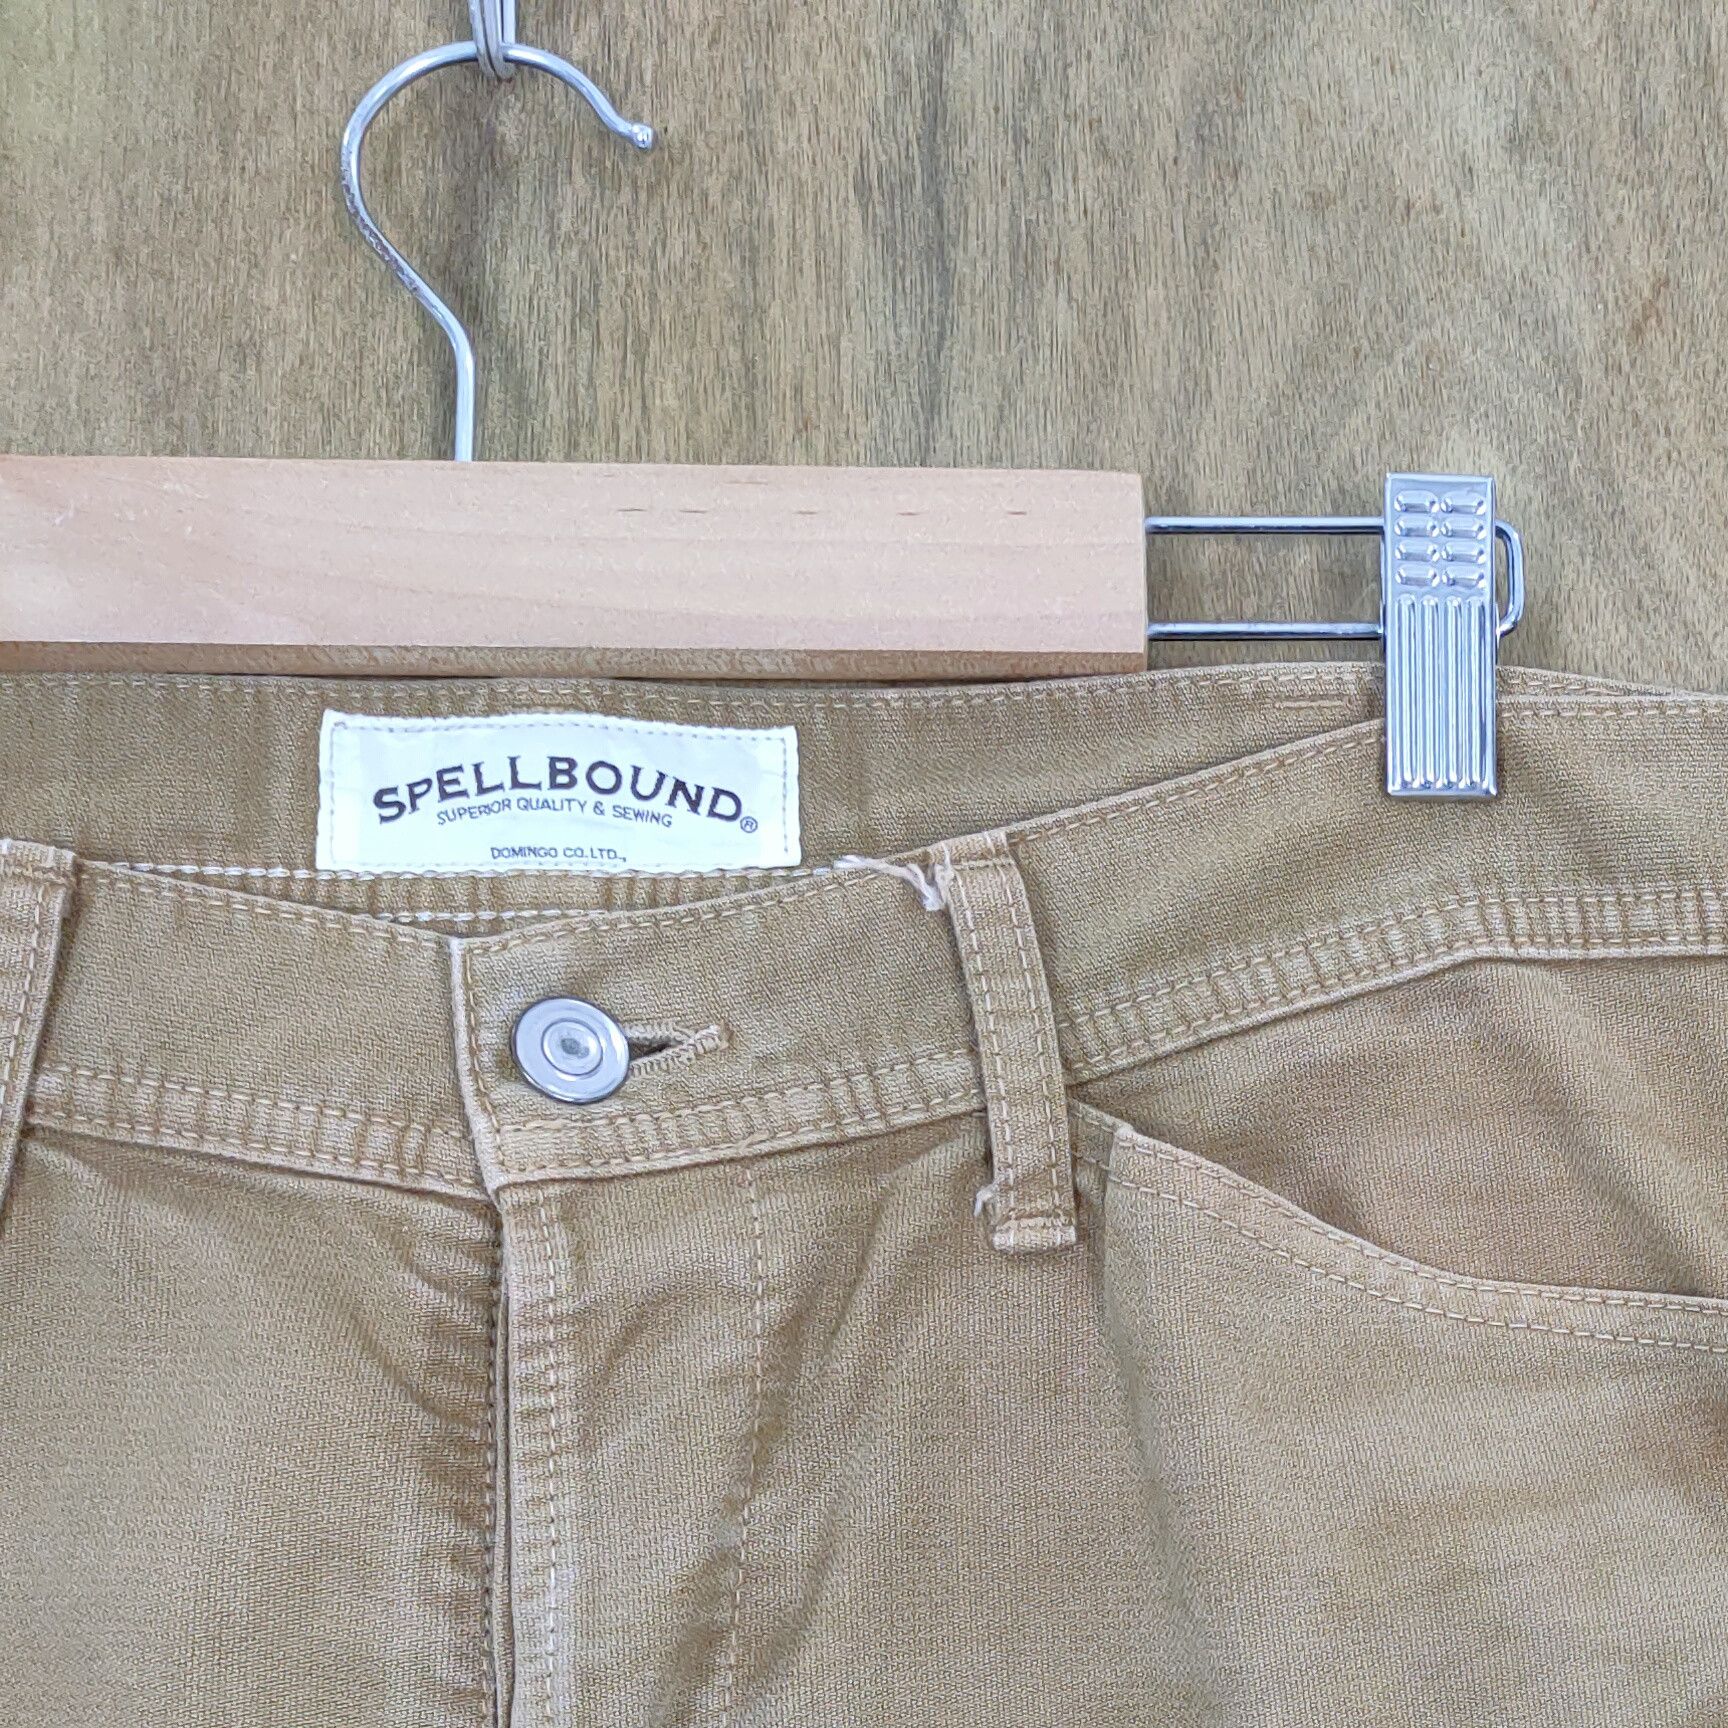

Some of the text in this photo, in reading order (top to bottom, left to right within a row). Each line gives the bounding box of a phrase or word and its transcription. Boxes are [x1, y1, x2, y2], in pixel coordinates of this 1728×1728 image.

[437, 796, 673, 828] SUPERIOR QUALITY & SEWING
[490, 846, 558, 860] DOMINGO
